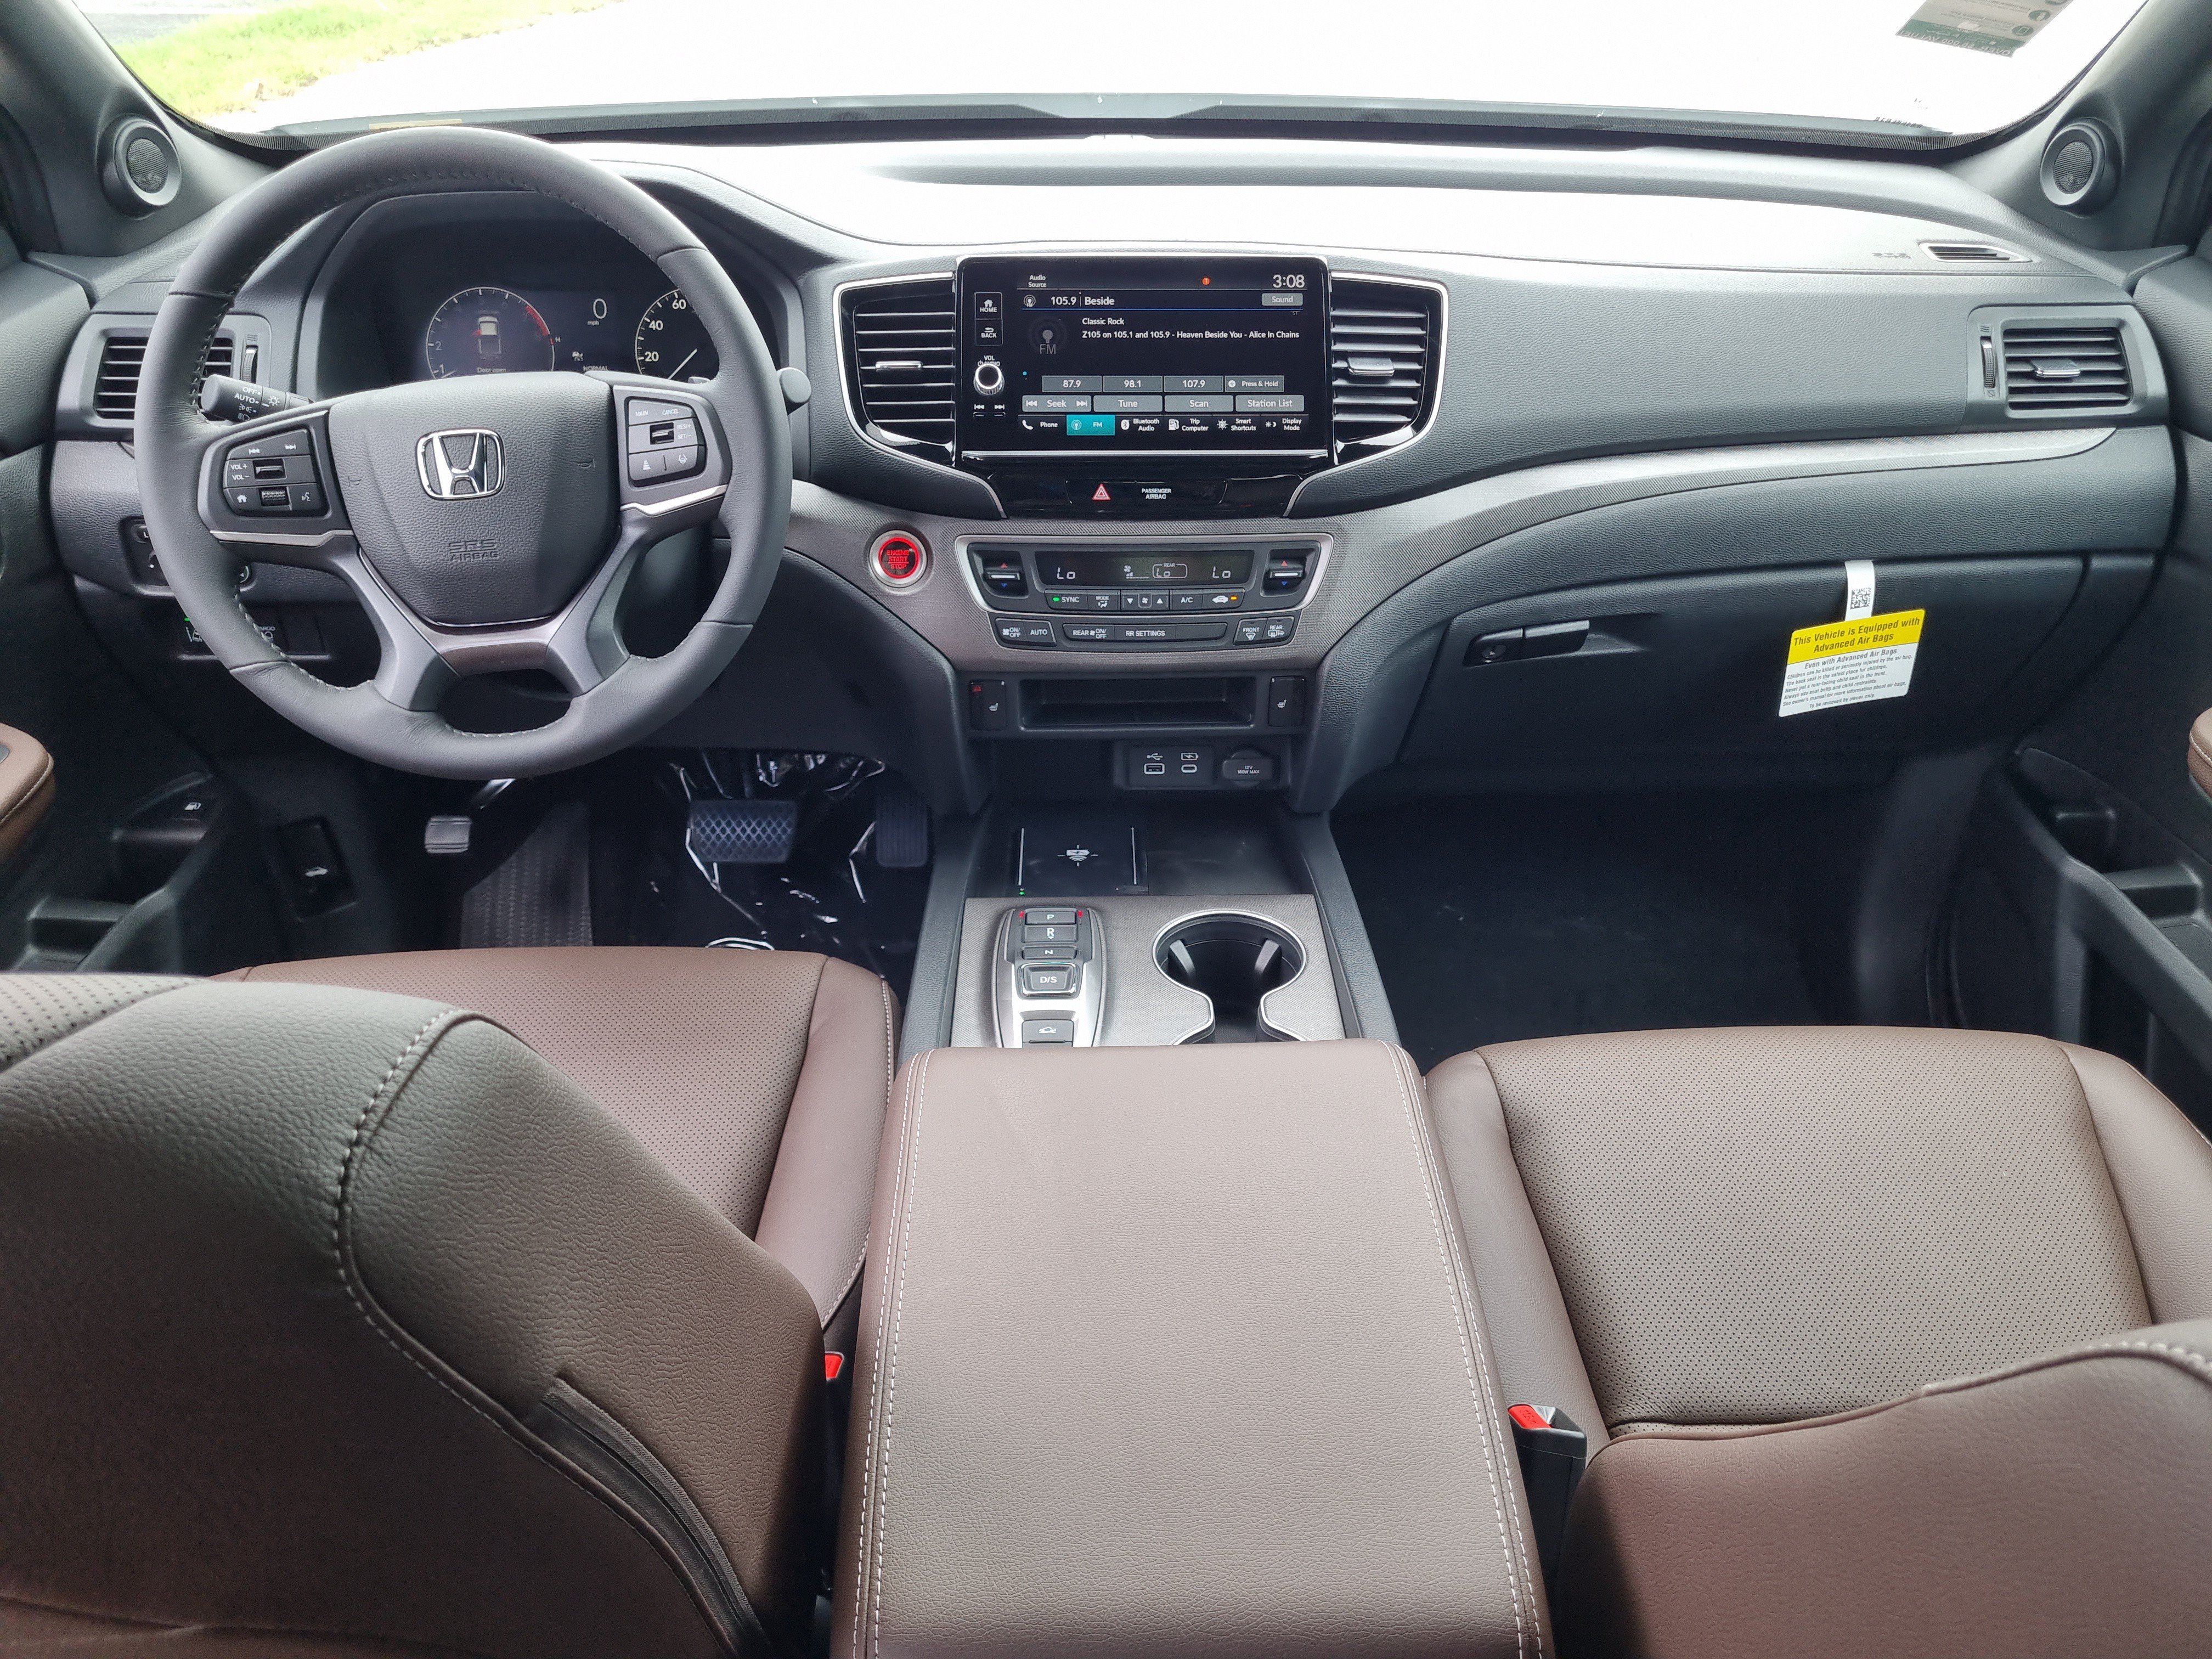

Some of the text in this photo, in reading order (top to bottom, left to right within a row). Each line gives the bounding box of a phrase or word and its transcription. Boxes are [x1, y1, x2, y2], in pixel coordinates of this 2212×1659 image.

[1273, 275, 1305, 288] 3:08
[672, 300, 686, 309] 60
[1051, 296, 1115, 306] 105.9 Beside
[593, 298, 607, 319] 0
[648, 320, 664, 330] 40
[435, 341, 442, 351] 2
[1040, 344, 1056, 354] FM
[645, 352, 659, 362] 20
[439, 364, 444, 374] 1
[242, 386, 258, 394] OFF
[234, 393, 256, 404] AUTO
[450, 551, 498, 561] AIRBAG
[1057, 567, 1075, 579] Lo
[1156, 568, 1170, 577] Lo
[1212, 566, 1231, 578] Lo
[1793, 617, 1920, 646] This Vehicle is Equipped with
[1813, 633, 1894, 653] Advanced Air Bags
[1821, 658, 1835, 666] with
[1836, 652, 1868, 663] Advanced
[1881, 648, 1898, 657] Bags
[1787, 672, 1805, 680] Children
[1841, 661, 1862, 670] seriously
[1811, 680, 1835, 688] rear-facing
[1854, 678, 1877, 686] restraints.
[1792, 697, 1809, 705] owner's
[1847, 685, 1872, 693] information
[1822, 698, 1842, 706] removed
[1047, 927, 1054, 936] R
